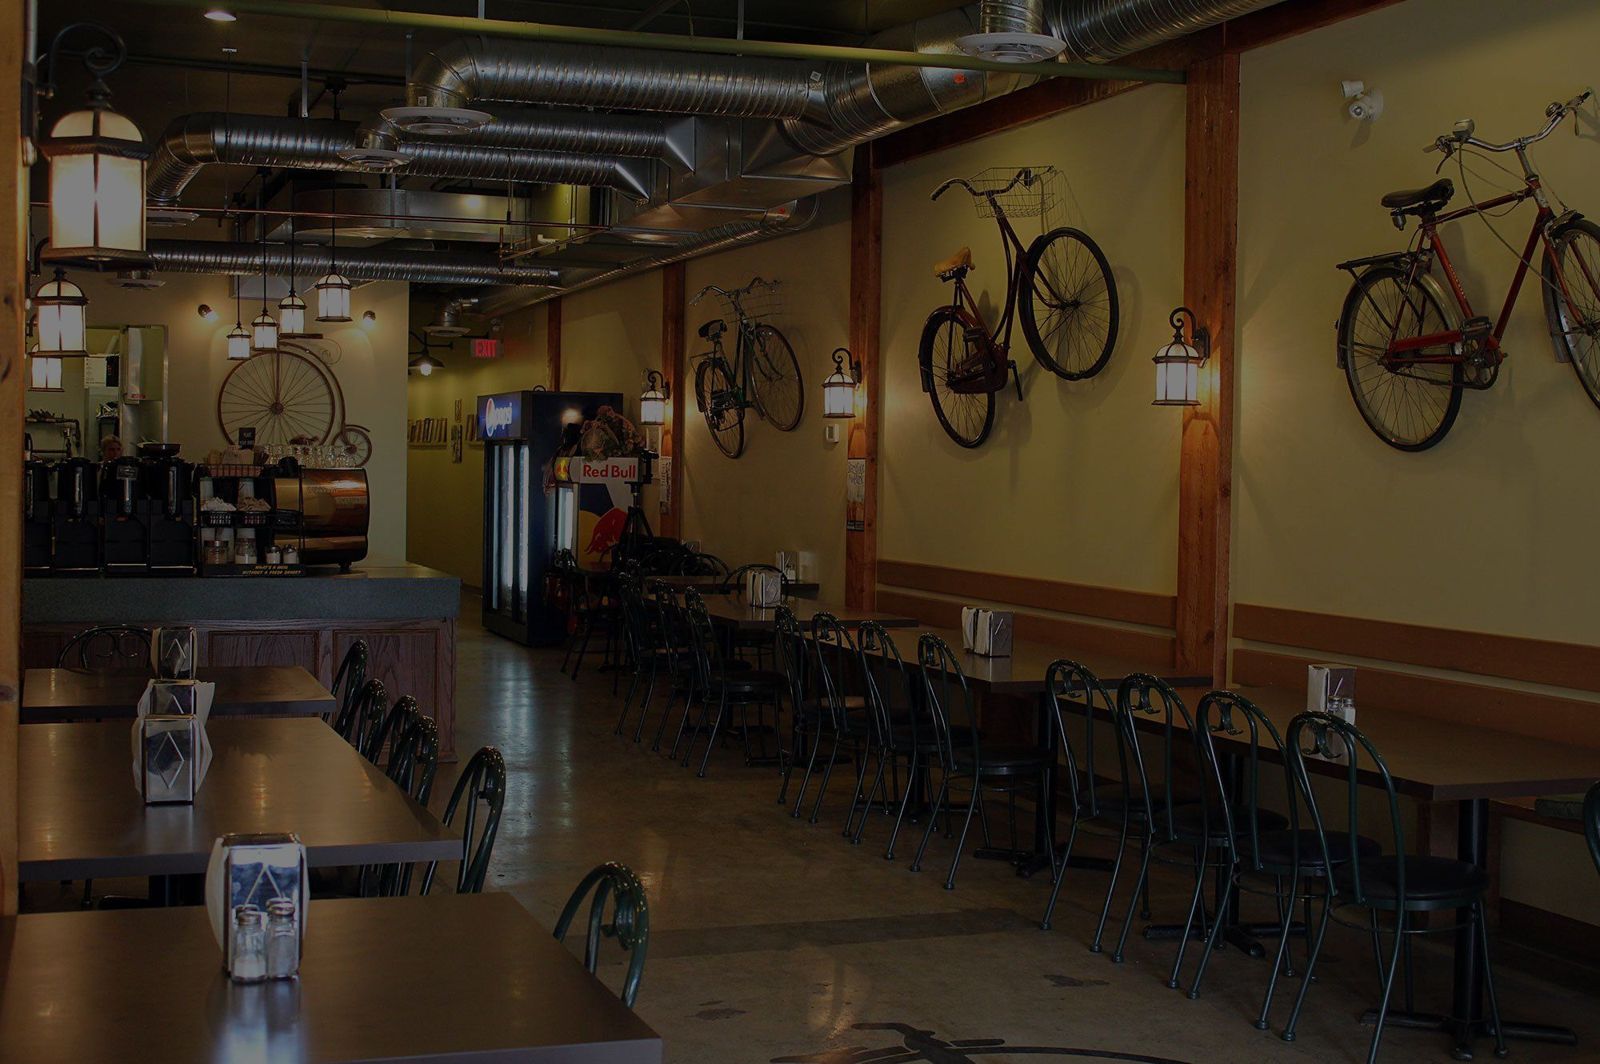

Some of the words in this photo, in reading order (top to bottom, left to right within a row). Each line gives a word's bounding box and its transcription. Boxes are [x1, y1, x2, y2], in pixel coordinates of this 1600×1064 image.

[474, 339, 497, 358] EXIT
[583, 464, 609, 478] Red
[611, 464, 636, 479] Bull
